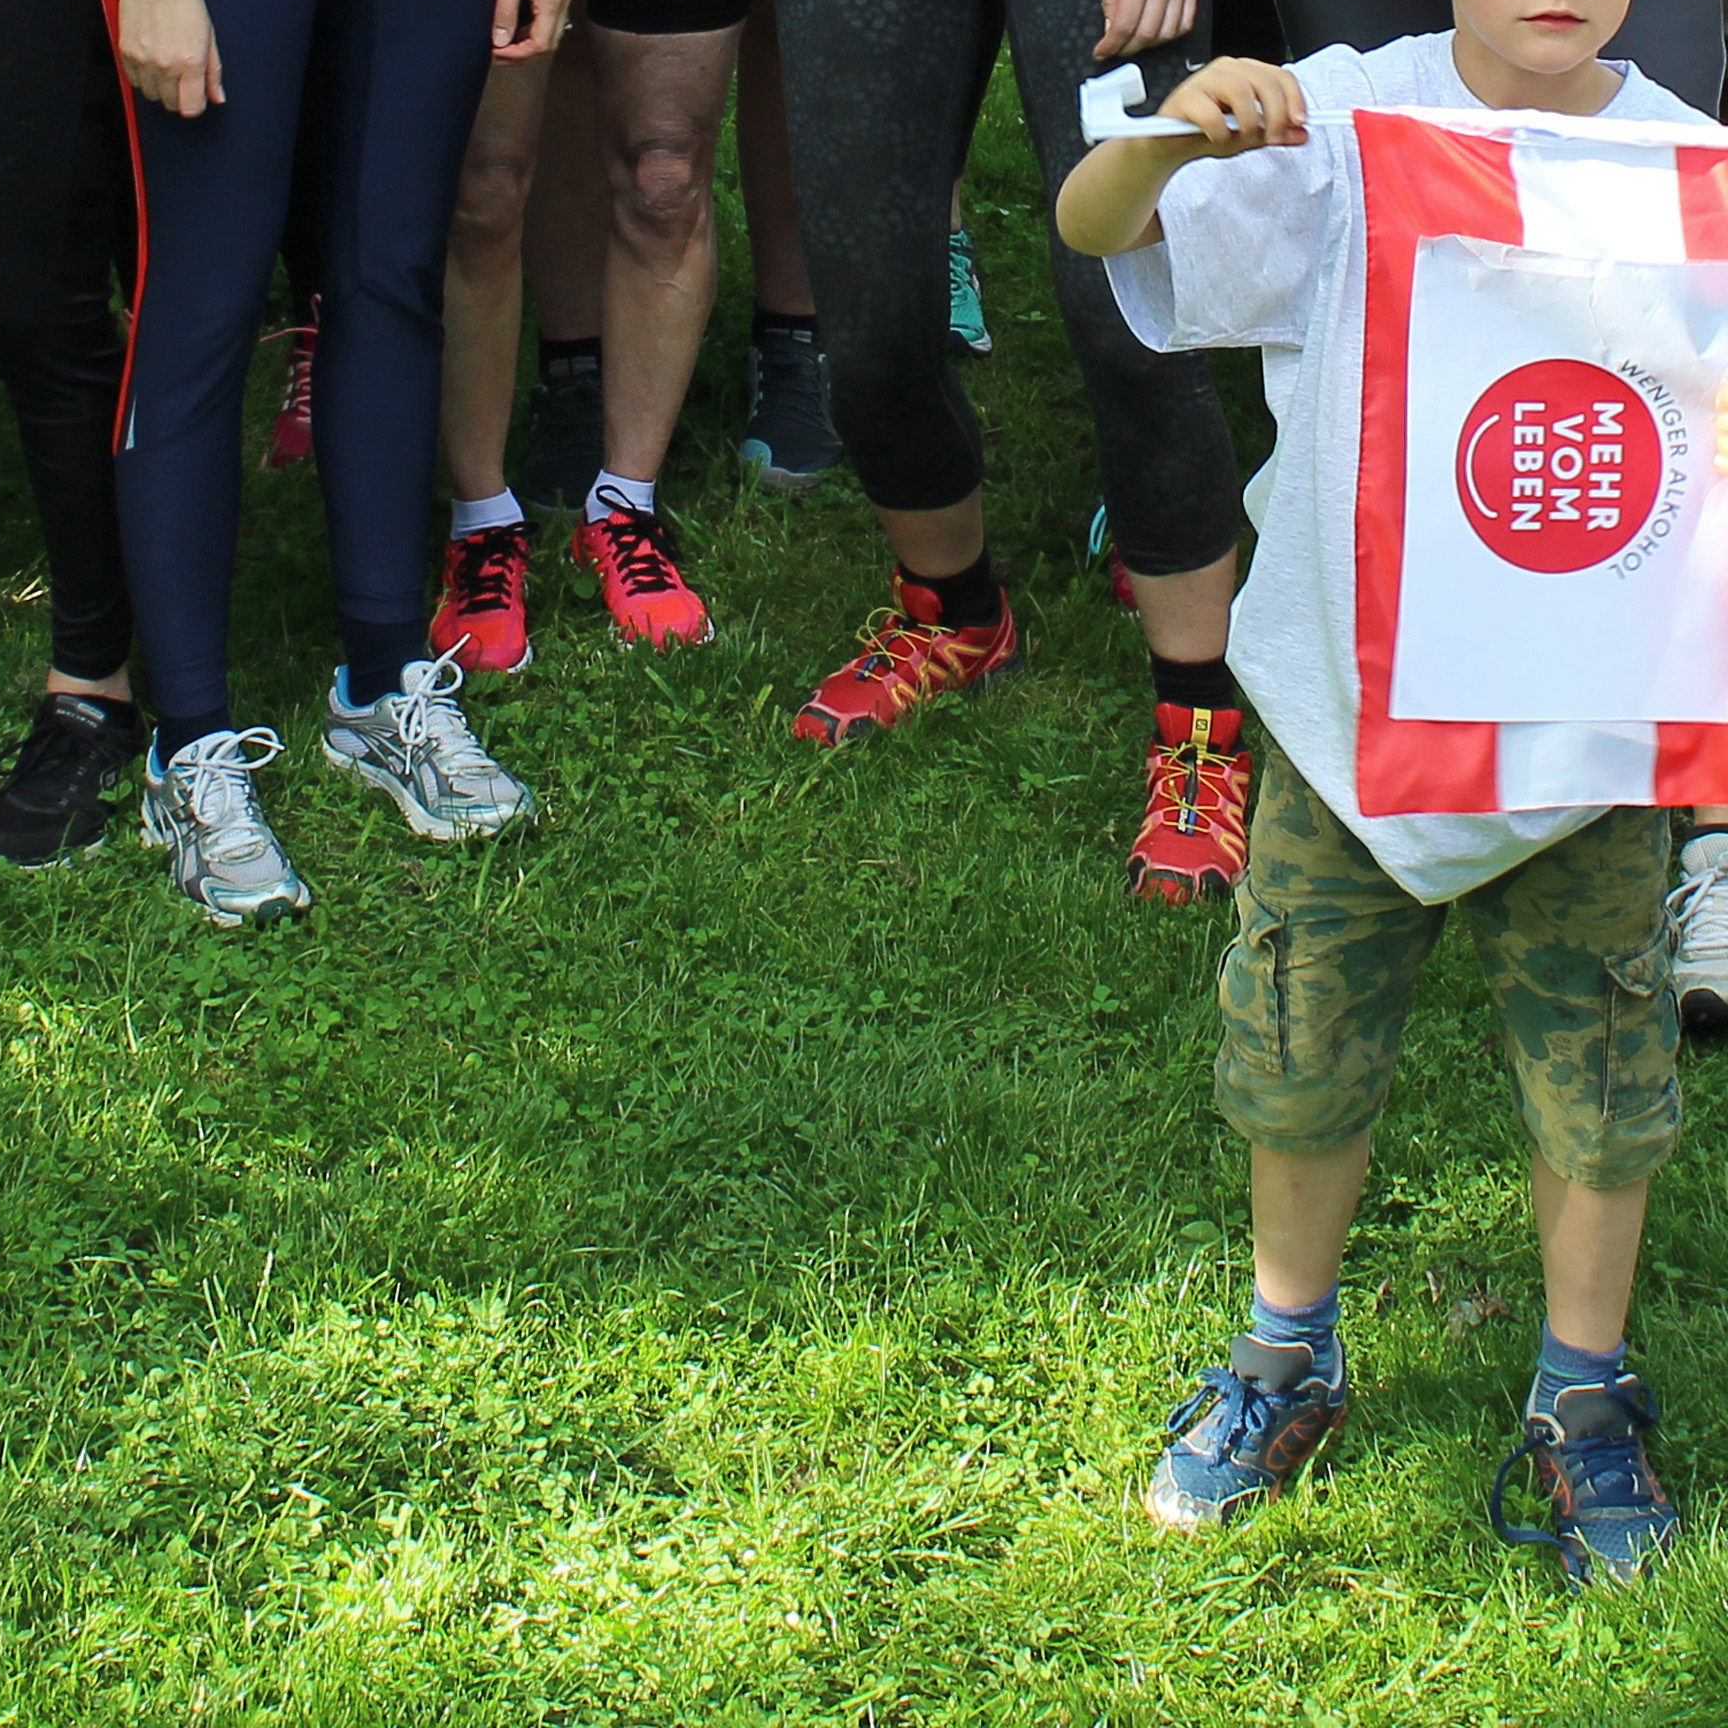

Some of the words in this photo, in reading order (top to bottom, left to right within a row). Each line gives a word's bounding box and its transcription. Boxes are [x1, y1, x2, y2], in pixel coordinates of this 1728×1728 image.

[1620, 359, 1688, 458] WENIGER
[1510, 402, 1545, 530] LEBEN
[1549, 414, 1585, 520] VOM
[1586, 402, 1625, 531] MEHR
[1608, 468, 1687, 580] ALKOHOL
